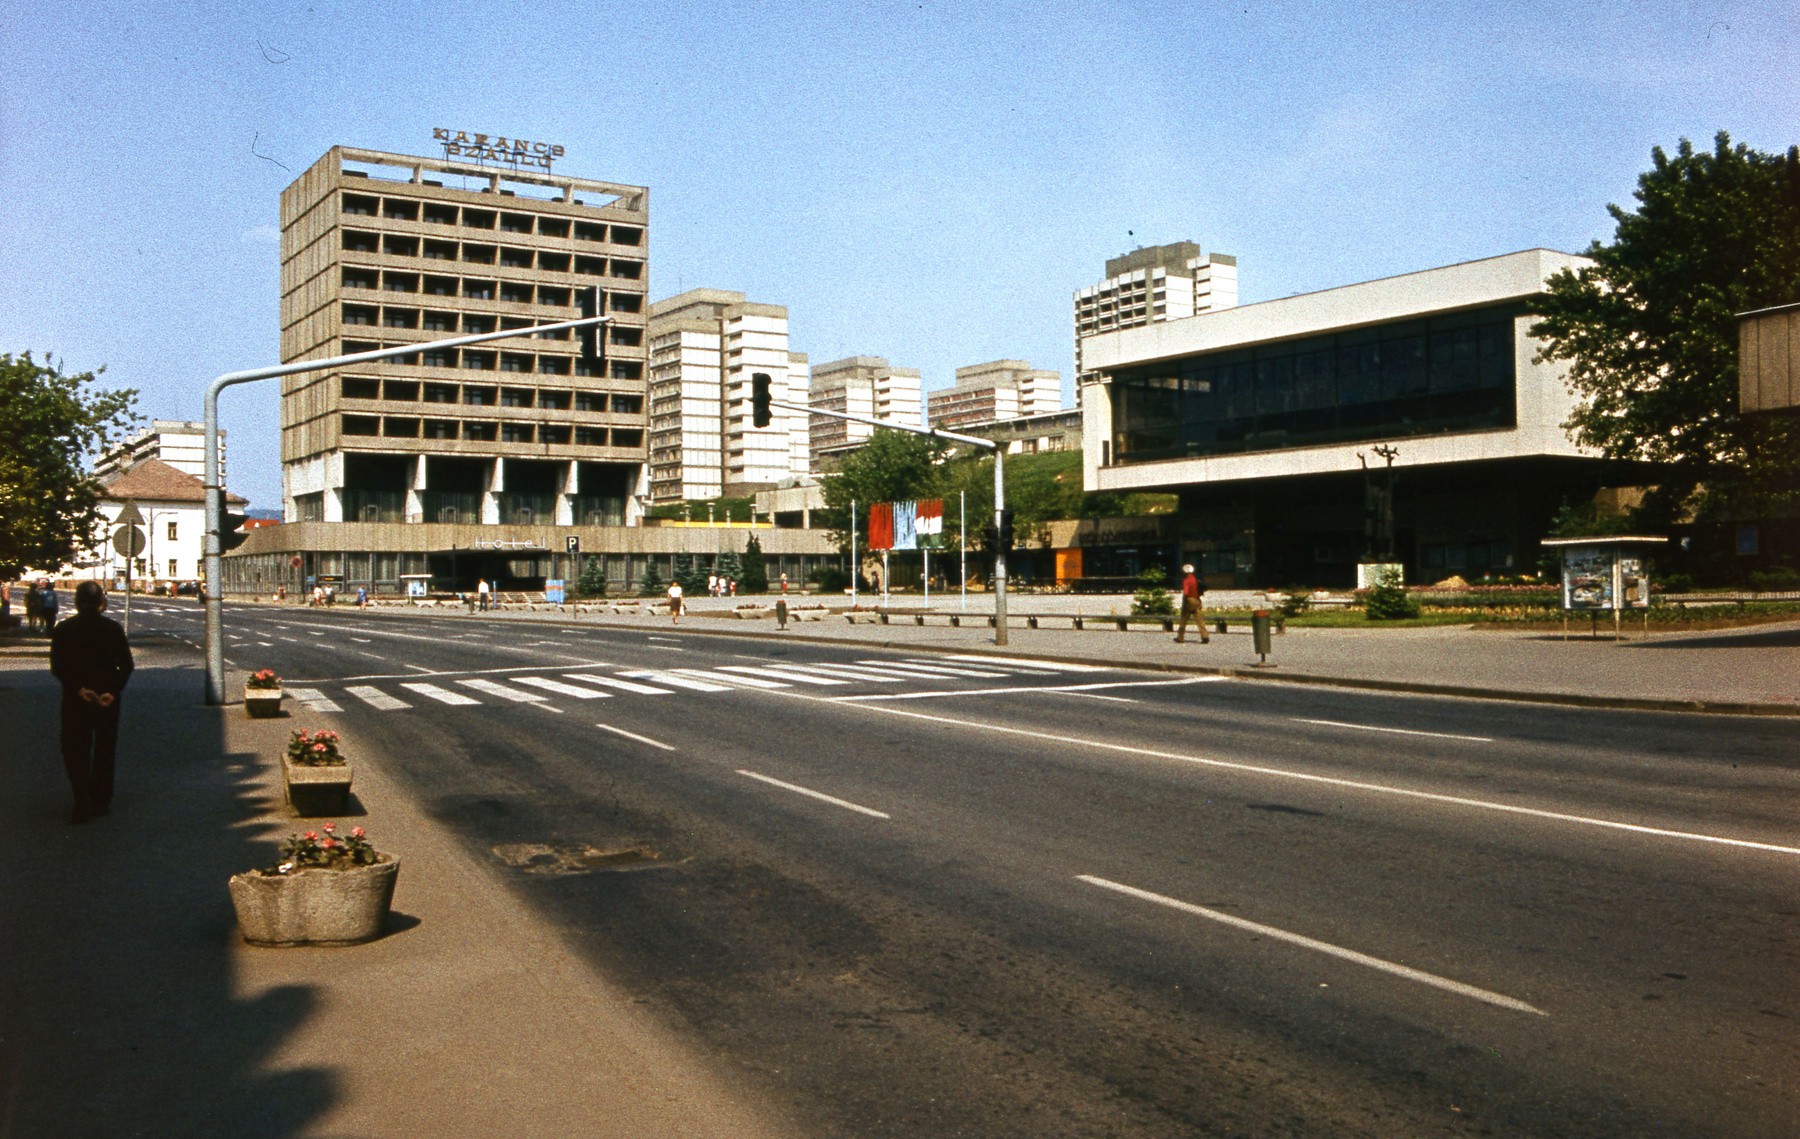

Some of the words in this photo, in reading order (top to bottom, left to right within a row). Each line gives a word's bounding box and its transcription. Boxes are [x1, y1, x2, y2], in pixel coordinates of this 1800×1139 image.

[433, 127, 565, 156] KARANCS
[475, 536, 546, 548] Hotel
[569, 537, 577, 549] P
